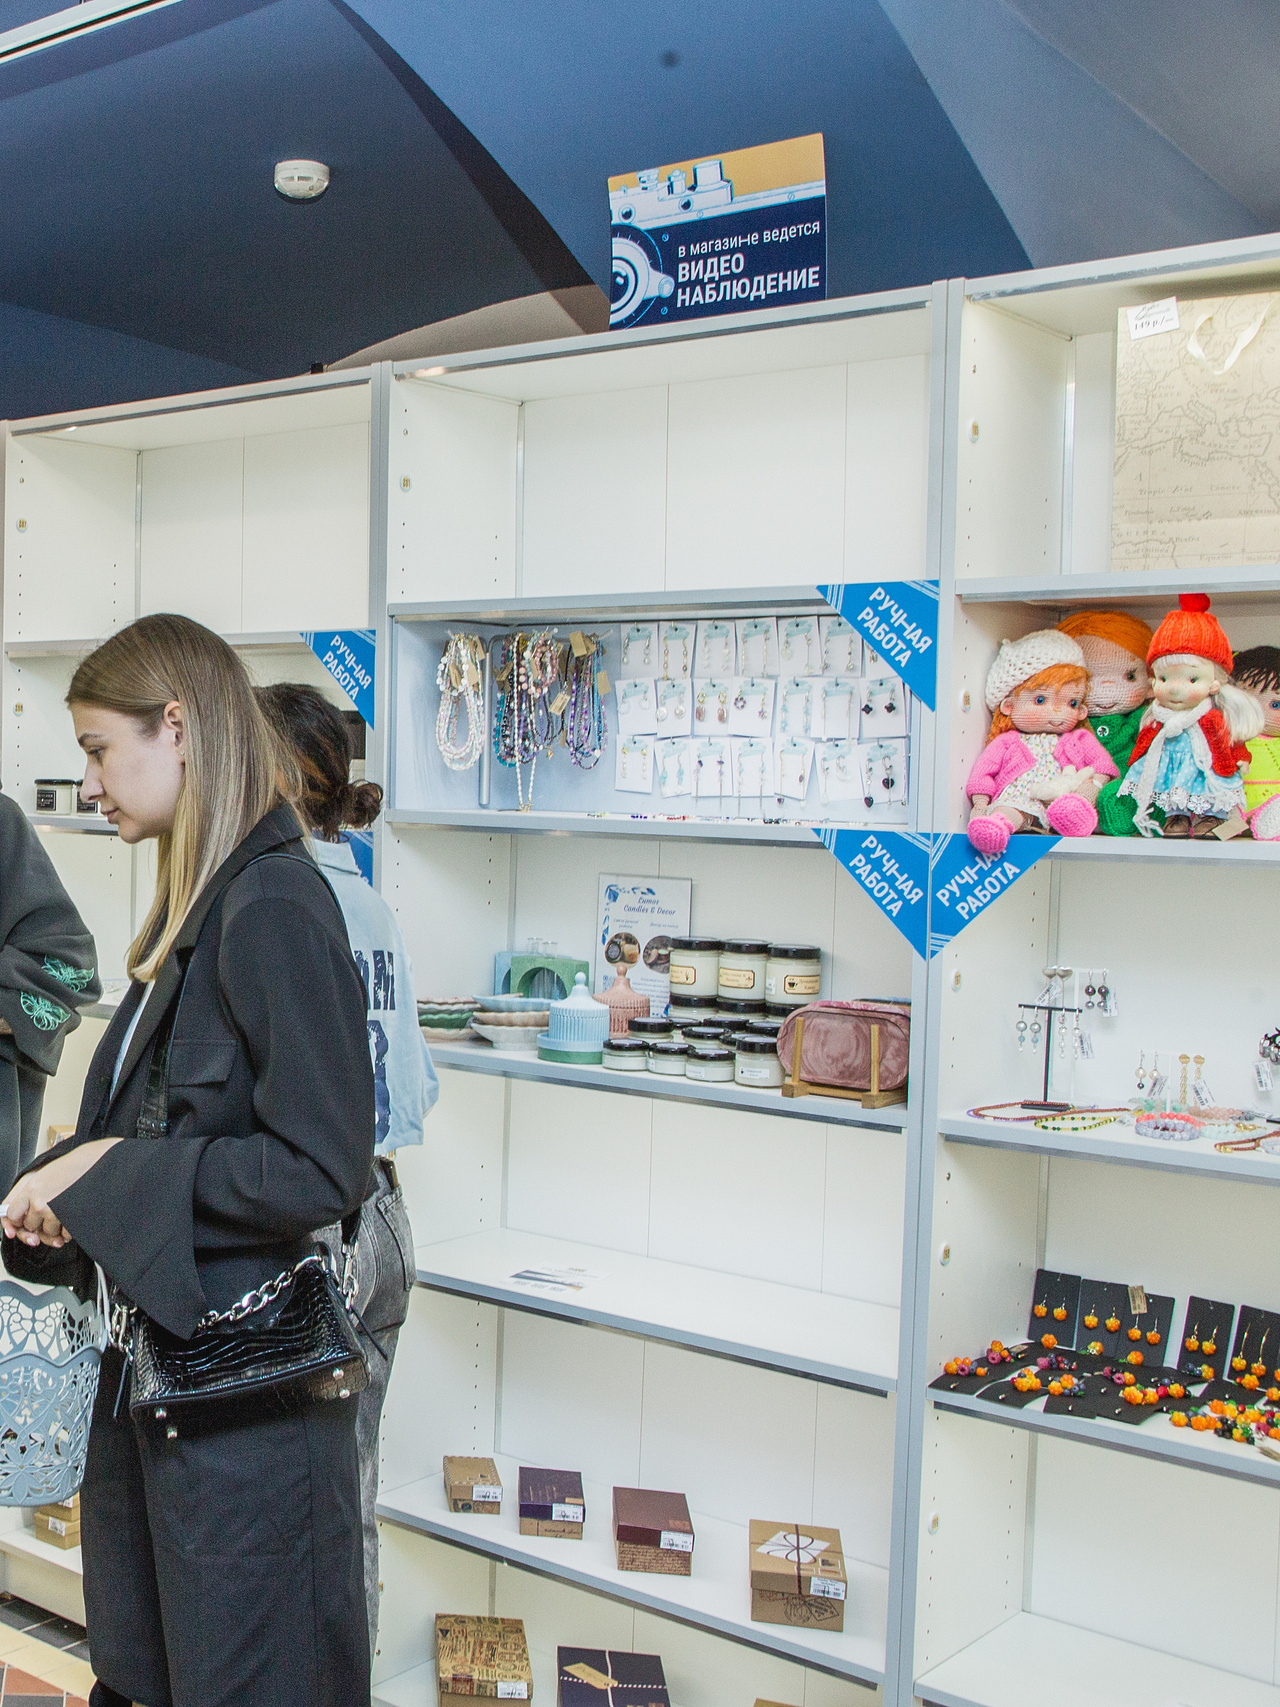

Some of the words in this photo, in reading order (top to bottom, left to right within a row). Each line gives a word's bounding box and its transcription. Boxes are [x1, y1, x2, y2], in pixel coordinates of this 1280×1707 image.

[677, 252, 745, 283] ВИДЕО
[678, 245, 686, 258] в
[690, 231, 759, 256] магазине
[763, 220, 820, 248] ведется
[676, 266, 821, 308] НАБЛЮДЕНИЕ
[857, 607, 913, 668] РАБОТА
[869, 586, 933, 655] РУЧНАЯ
[322, 650, 360, 701] РАБОТА
[330, 634, 372, 690] РУЧНАЯ
[848, 853, 904, 917] РАБОТА
[861, 835, 924, 905] РУЧНАЯ
[936, 849, 1007, 907] РУЧНА
[955, 861, 1020, 921] РАБОТА
[623, 904, 649, 914] Candles
[657, 907, 677, 916] Decor
